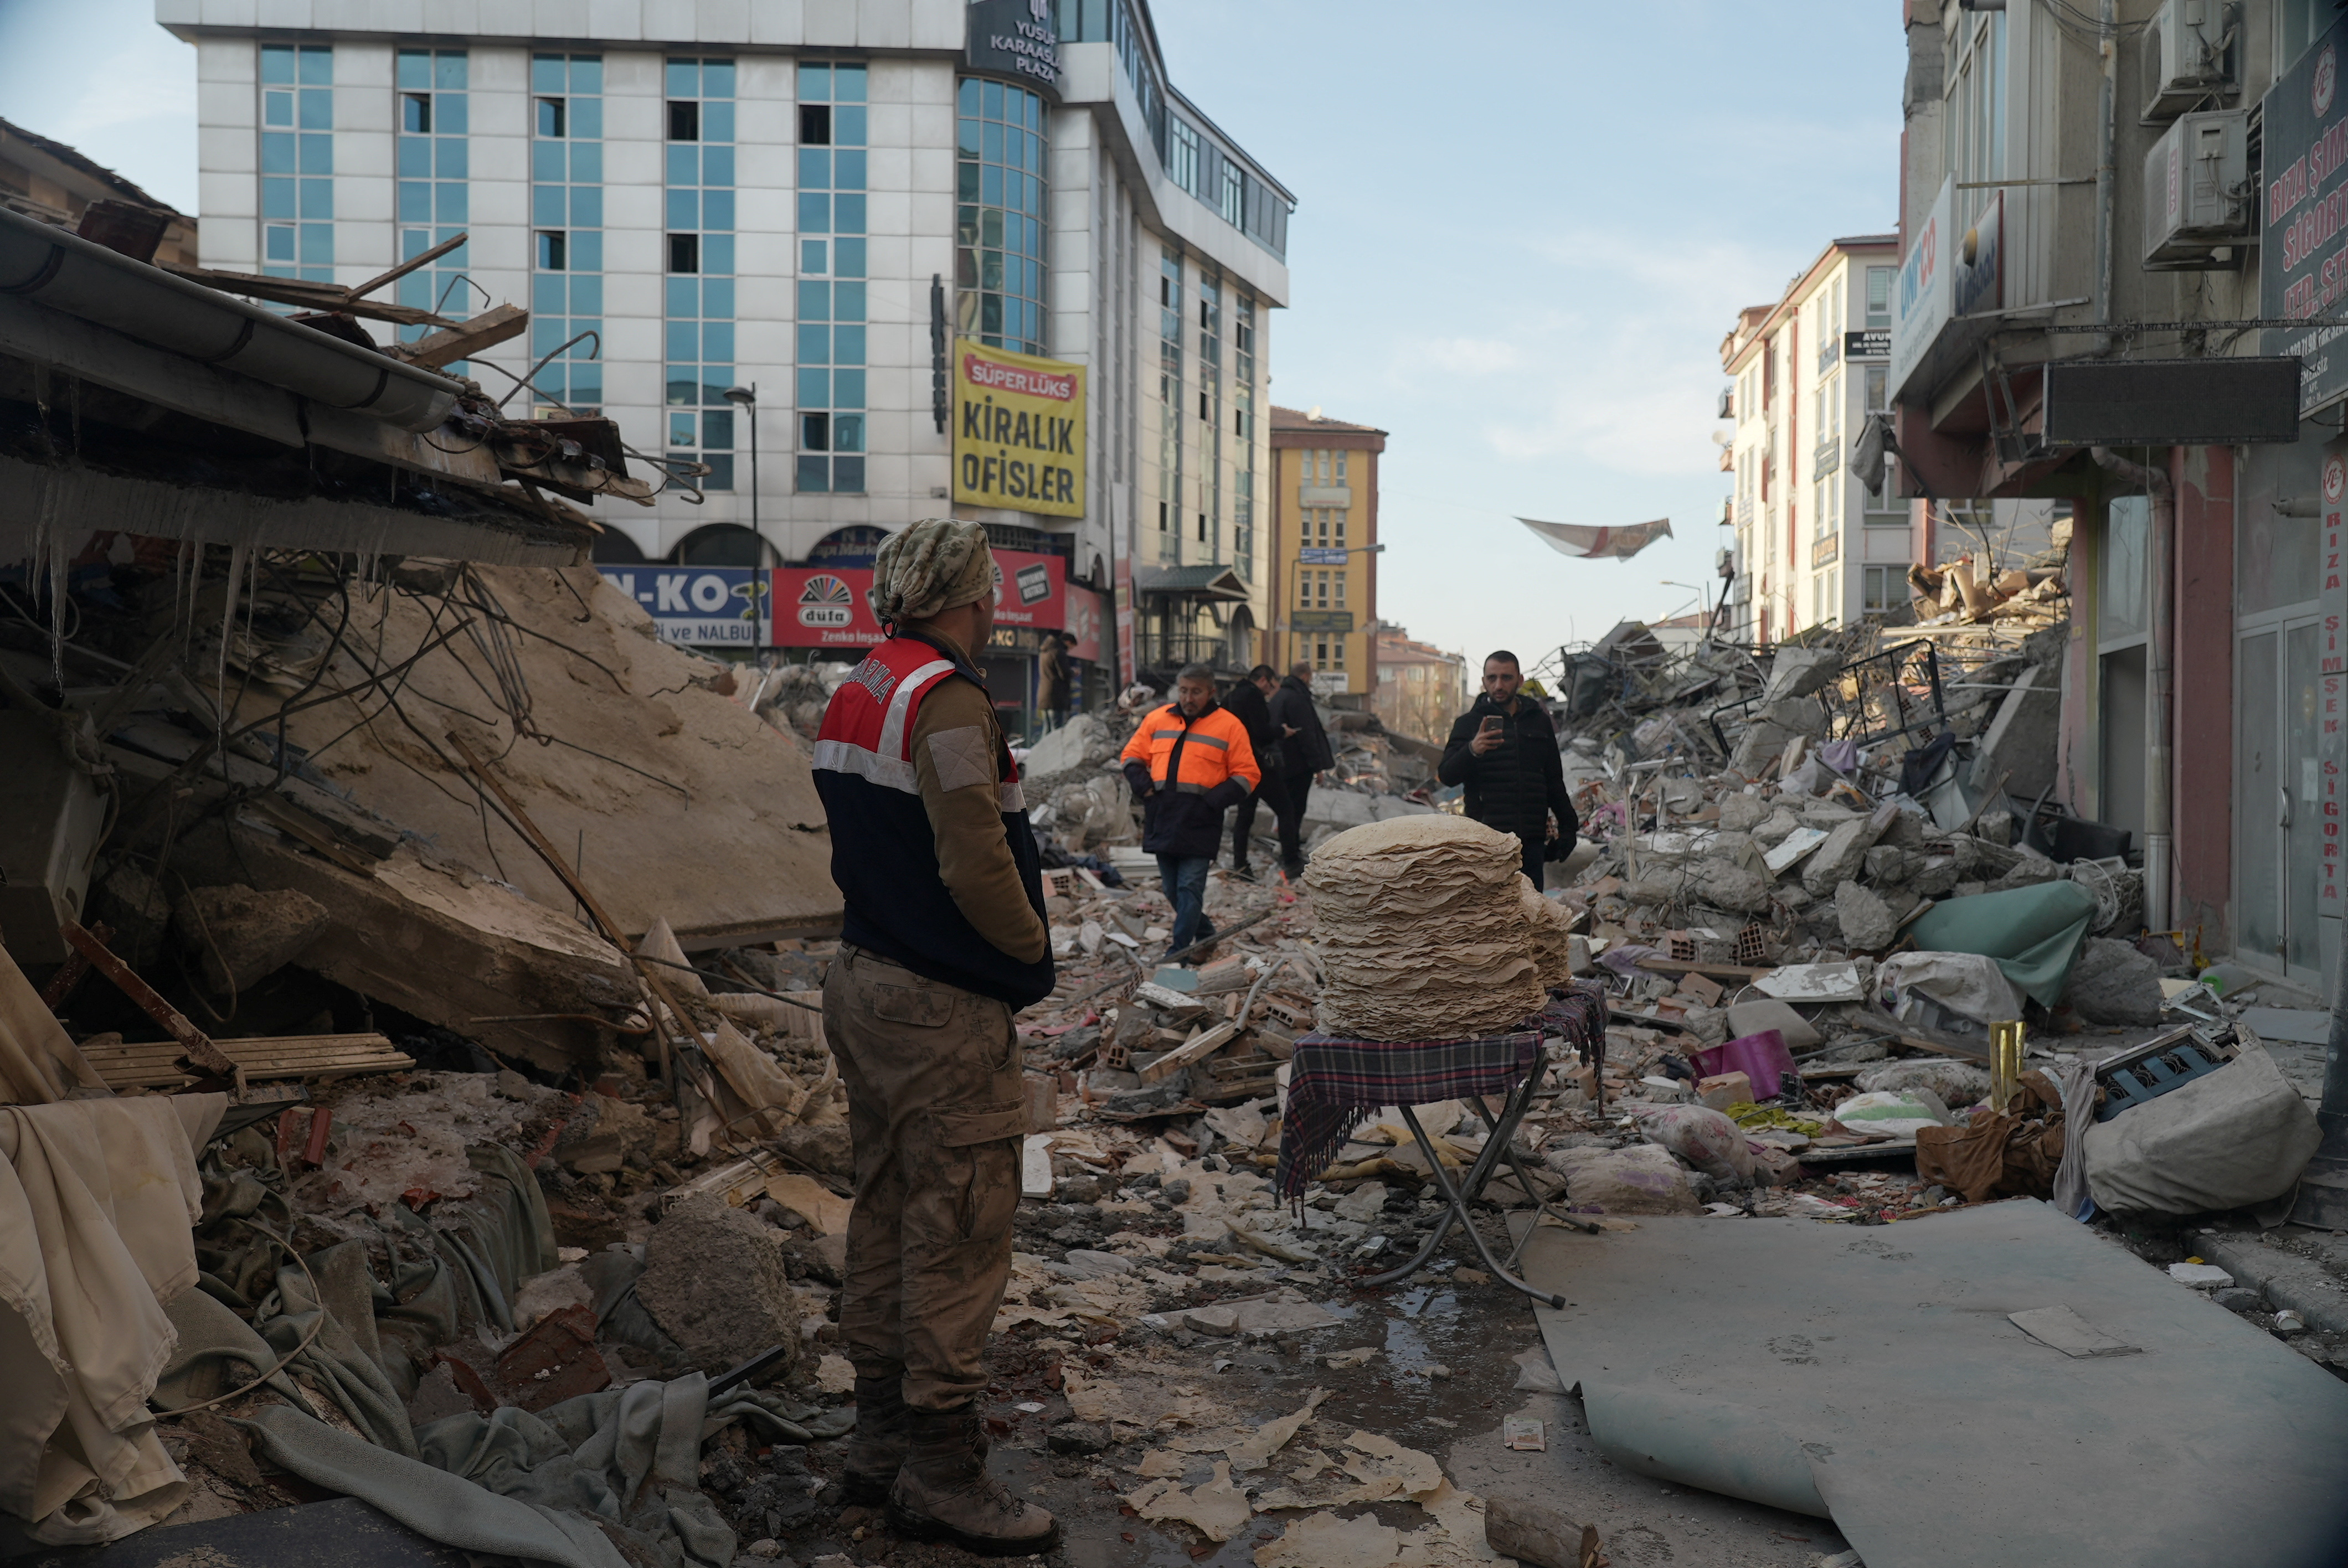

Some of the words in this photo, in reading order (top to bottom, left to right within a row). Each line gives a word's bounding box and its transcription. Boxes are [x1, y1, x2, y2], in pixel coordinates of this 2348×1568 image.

[1015, 20, 1056, 45] YUSUF
[1016, 56, 1055, 83] PLAZA
[2269, 154, 2307, 228] RIZA
[2283, 178, 2348, 272] SİGORT
[2284, 273, 2319, 333] LTD.
[972, 362, 1026, 391] SÜPER
[1029, 373, 1070, 399] LÜKS
[964, 395, 1074, 455] KİRALIK
[962, 449, 1074, 504] OFİSLER
[2326, 512, 2340, 591] RIZA
[671, 627, 692, 640] ve
[806, 610, 845, 622] düfa
[821, 631, 856, 644] Zenko
[857, 628, 890, 646] İnşaa
[2322, 615, 2342, 734] ŞİMŞEK
[2323, 760, 2339, 899] SİGORTA
